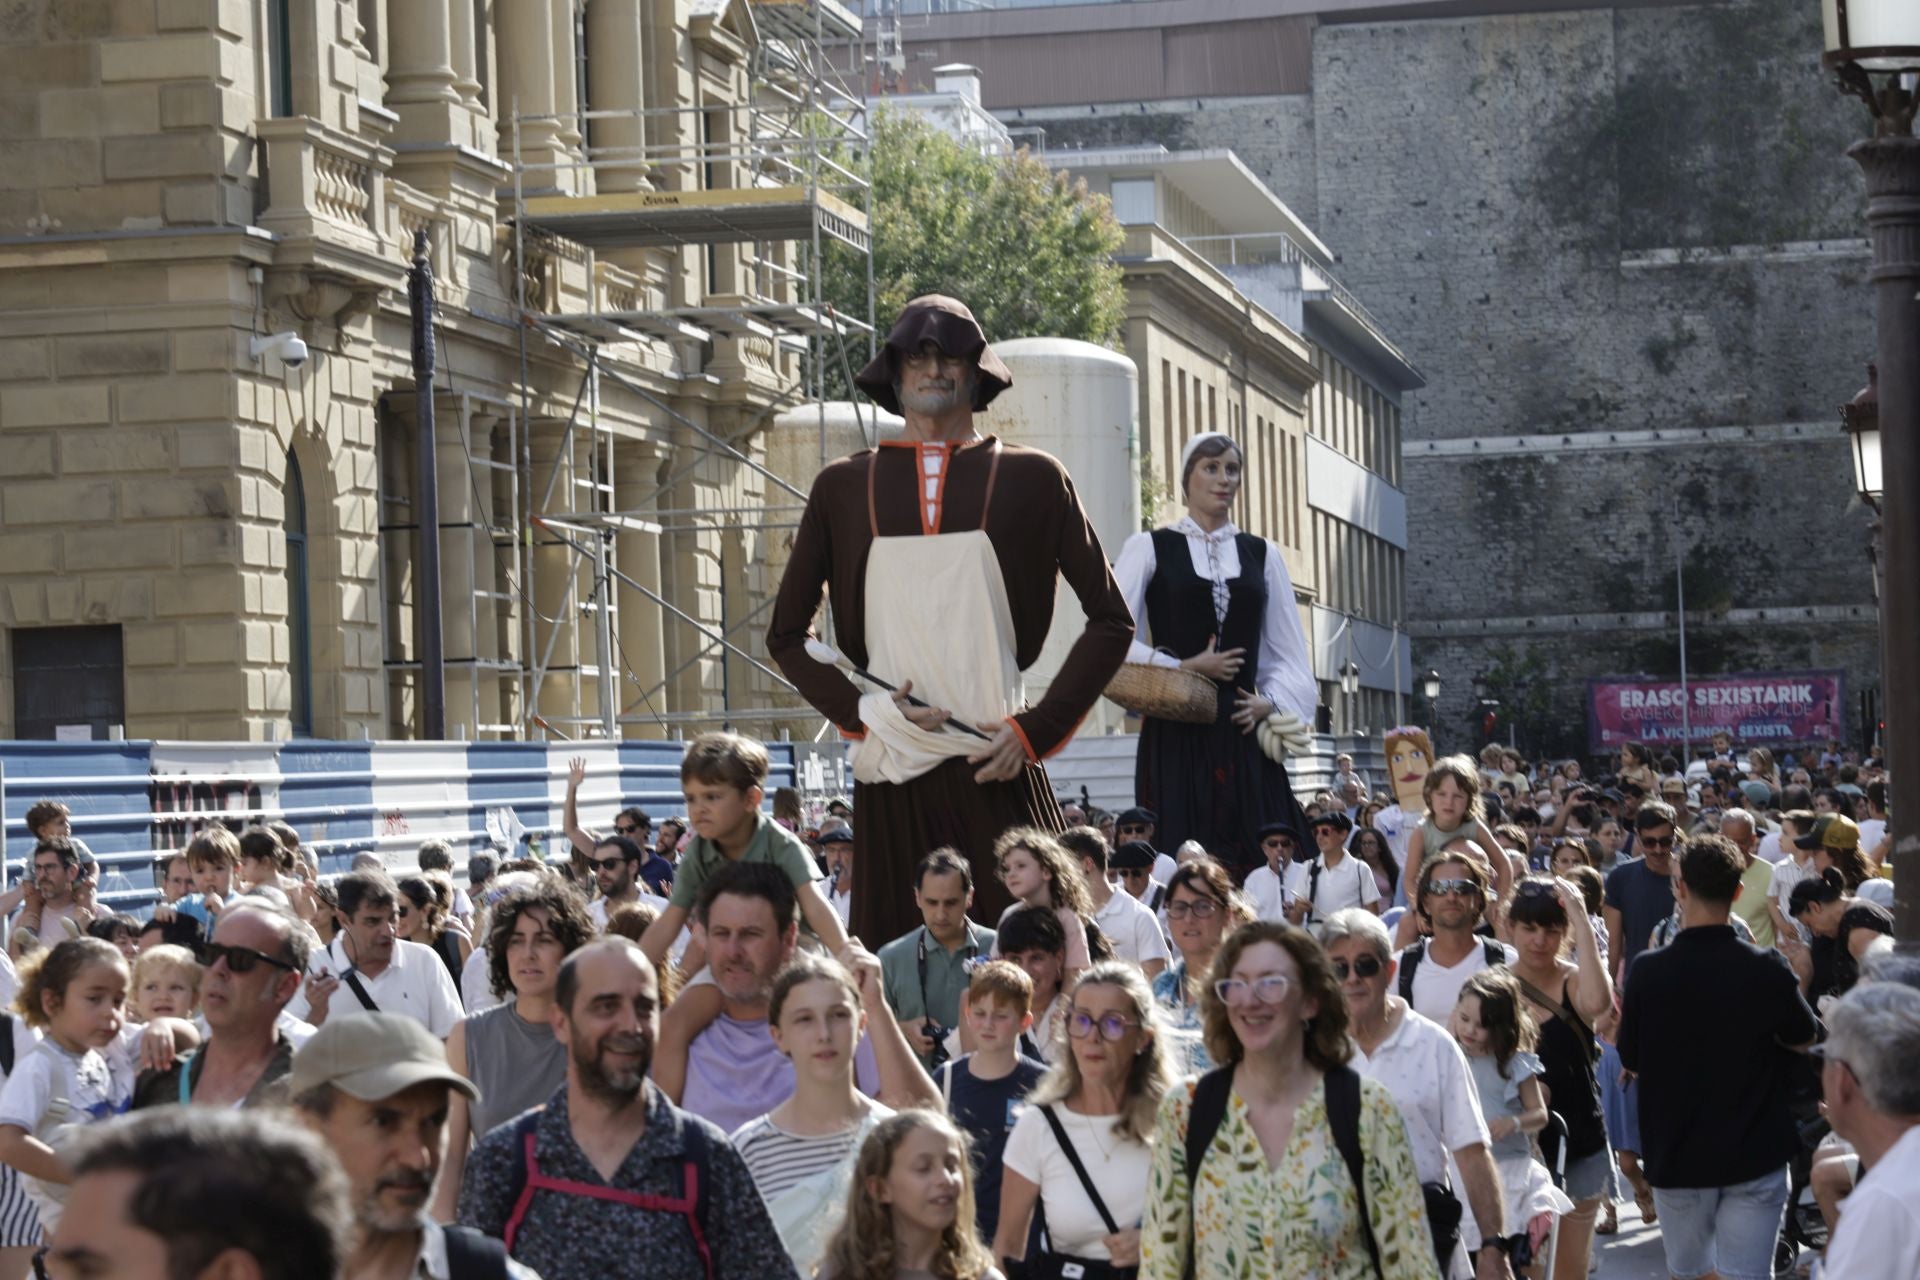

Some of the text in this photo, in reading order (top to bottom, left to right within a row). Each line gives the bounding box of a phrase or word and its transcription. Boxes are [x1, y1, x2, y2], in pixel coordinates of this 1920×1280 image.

[1619, 684, 1813, 708] ERASO SEXISTARIK
[1641, 727, 1658, 740] LA
[1738, 724, 1793, 738] SEXISTA
